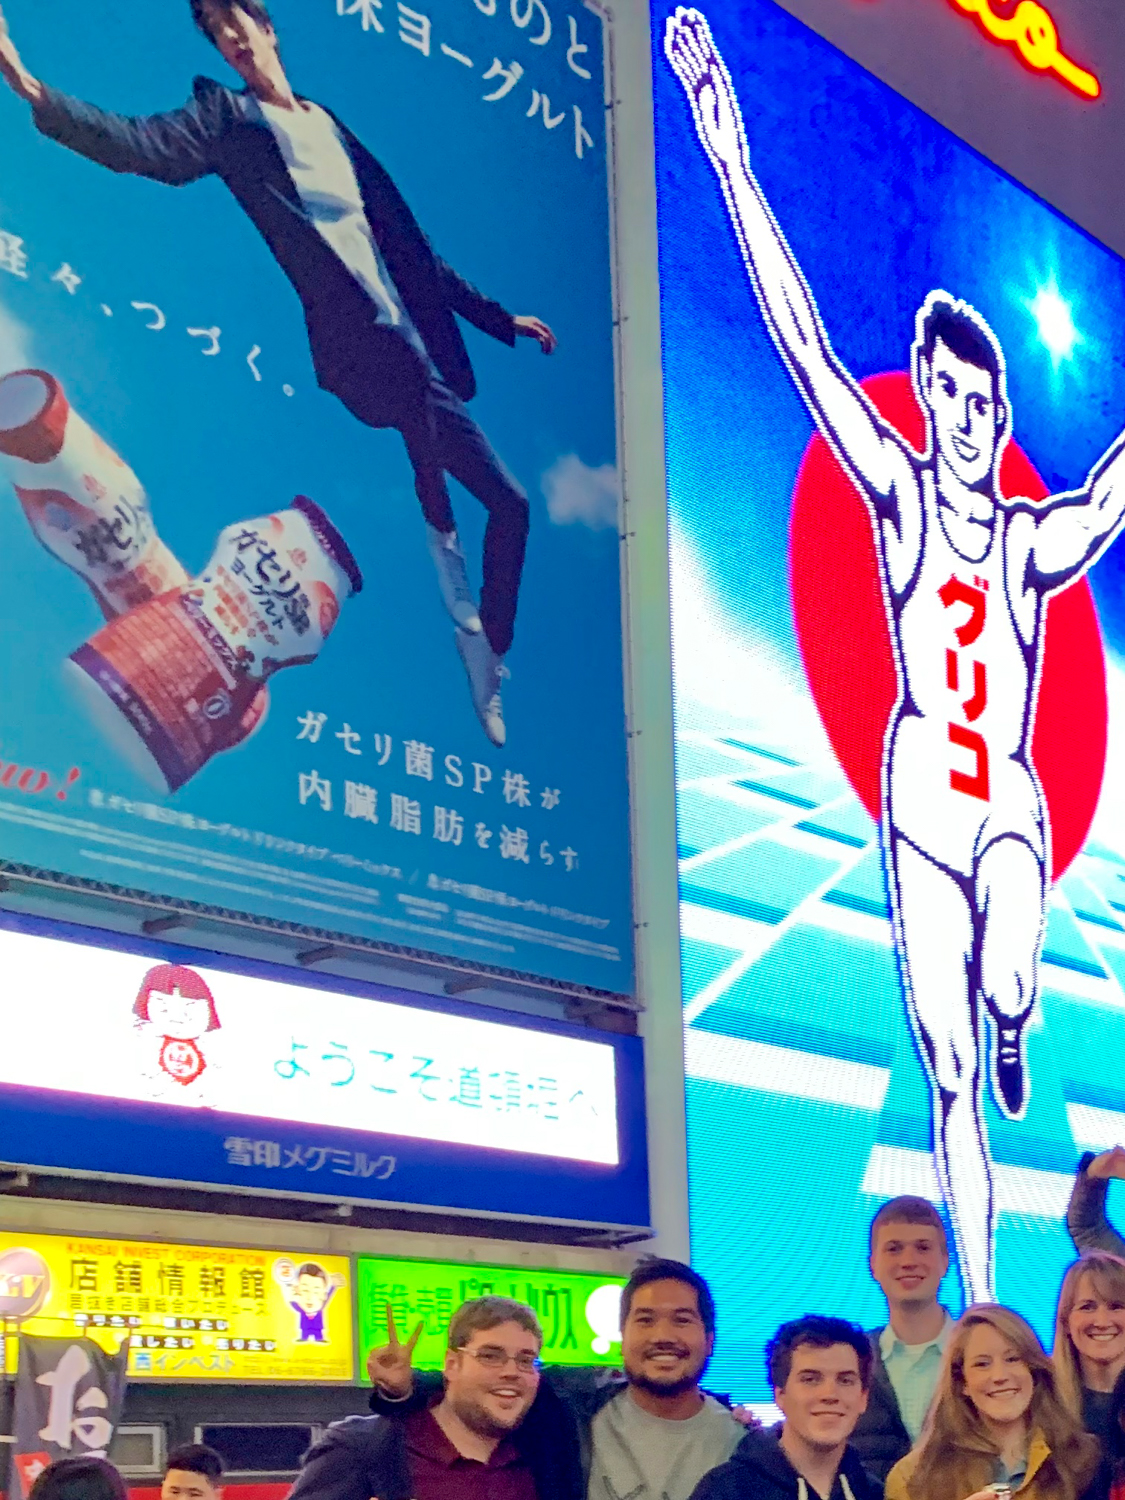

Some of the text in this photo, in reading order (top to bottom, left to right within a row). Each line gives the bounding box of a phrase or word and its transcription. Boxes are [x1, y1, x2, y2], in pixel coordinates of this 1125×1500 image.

[937, 573, 991, 803] グリコ
[296, 710, 562, 810] ガセリ菌SP株が
[299, 769, 579, 872] 内臓脂肪を減らす
[223, 1136, 397, 1180] 雪印メグミルク
